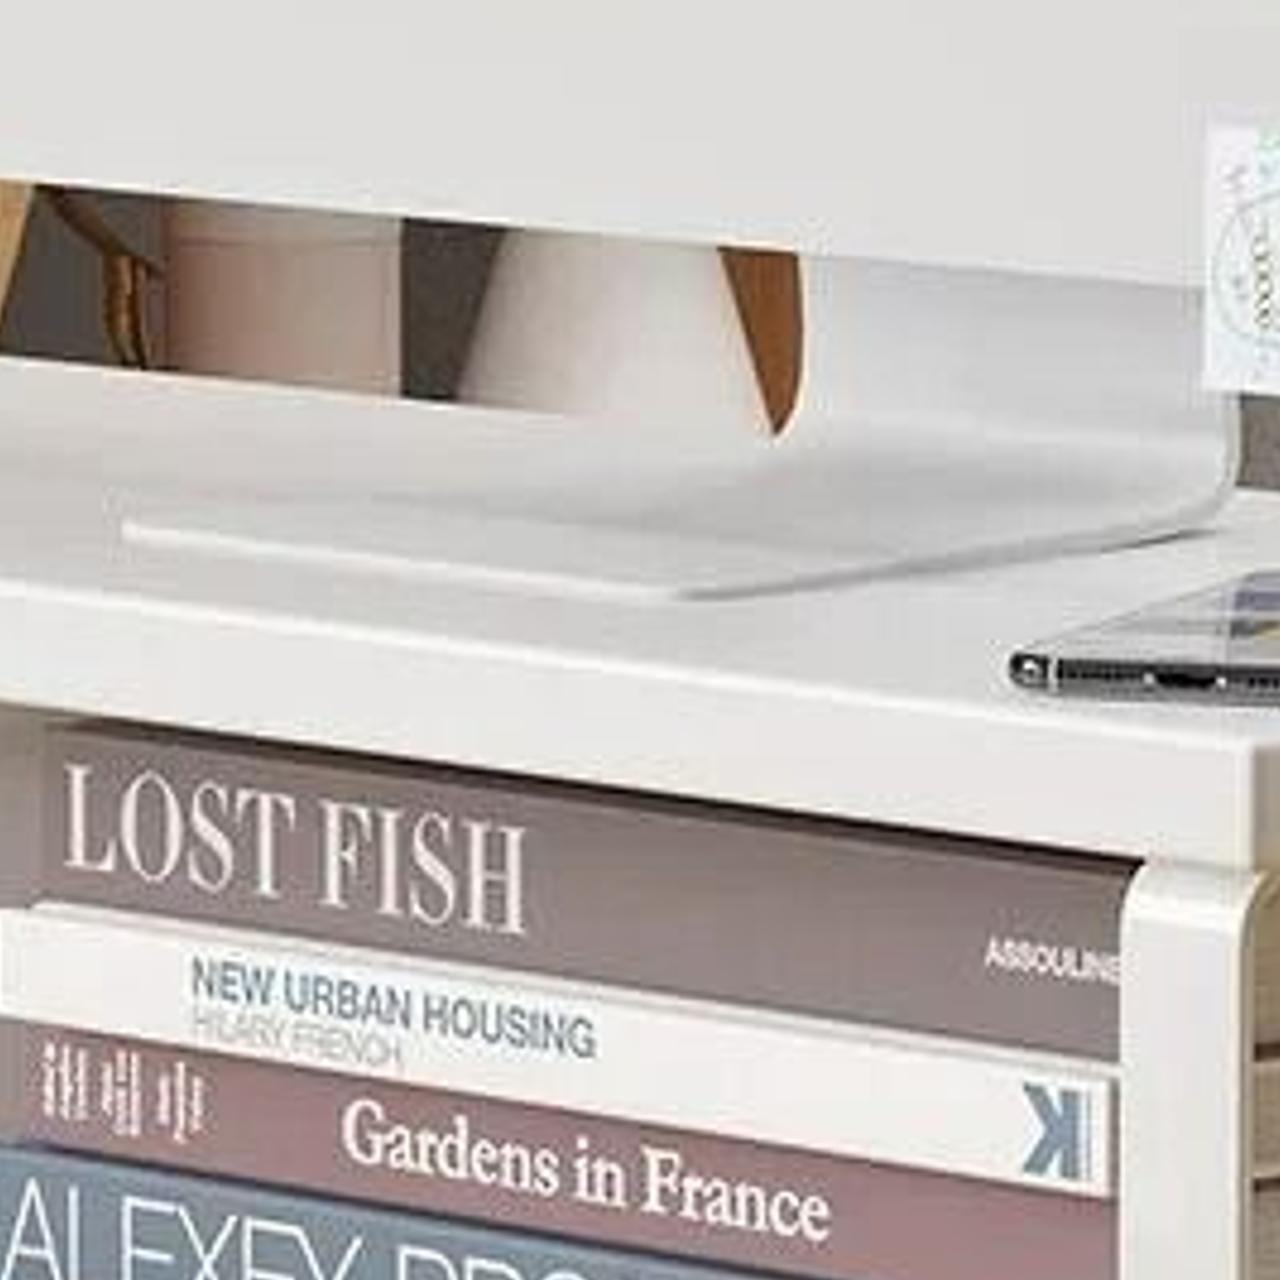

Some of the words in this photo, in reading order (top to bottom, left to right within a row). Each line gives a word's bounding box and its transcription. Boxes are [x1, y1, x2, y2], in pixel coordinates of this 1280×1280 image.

[63, 762, 295, 899] LOST
[321, 797, 526, 936] FISH
[192, 957, 275, 1007] NEW
[284, 969, 411, 1028] URBAN
[423, 996, 597, 1058] HOUSING
[342, 1100, 563, 1197] Gardens
[574, 1138, 624, 1208] in
[642, 1147, 831, 1240] France
